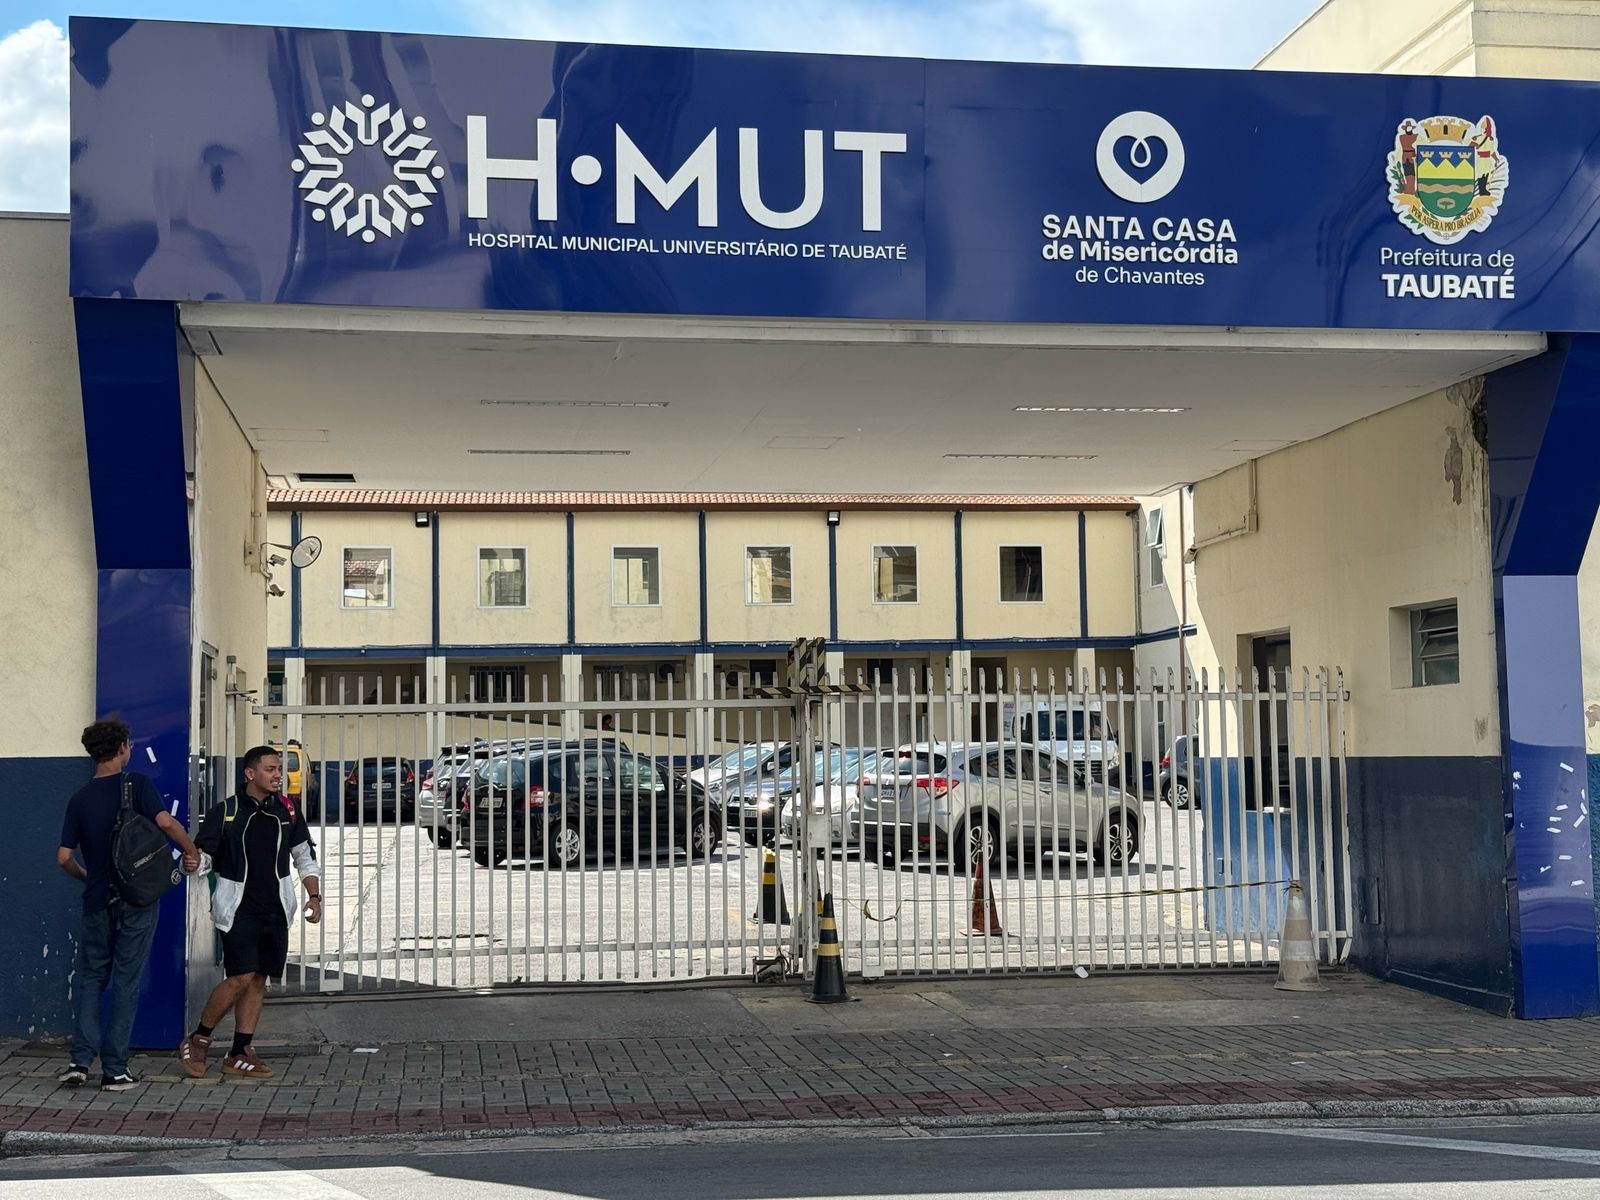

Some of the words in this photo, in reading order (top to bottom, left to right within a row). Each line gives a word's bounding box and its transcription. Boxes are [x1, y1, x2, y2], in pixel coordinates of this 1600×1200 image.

[1042, 213, 1145, 240] SANTA
[1152, 218, 1237, 242] CASA
[468, 232, 559, 250] HOSPITAL
[562, 236, 659, 253] MUNICIPAL
[662, 239, 799, 257] UNIVERSITÁRIO
[802, 243, 826, 258] DE
[828, 242, 907, 260] TAUBATÉ
[1042, 241, 1074, 260] de
[1080, 240, 1238, 264] Misericórdia
[1381, 247, 1482, 267] Prefeitura
[1487, 249, 1515, 267] de
[1075, 265, 1099, 283] de
[1105, 267, 1205, 285] Chavantes
[1382, 269, 1515, 299] TAUBATÉ
